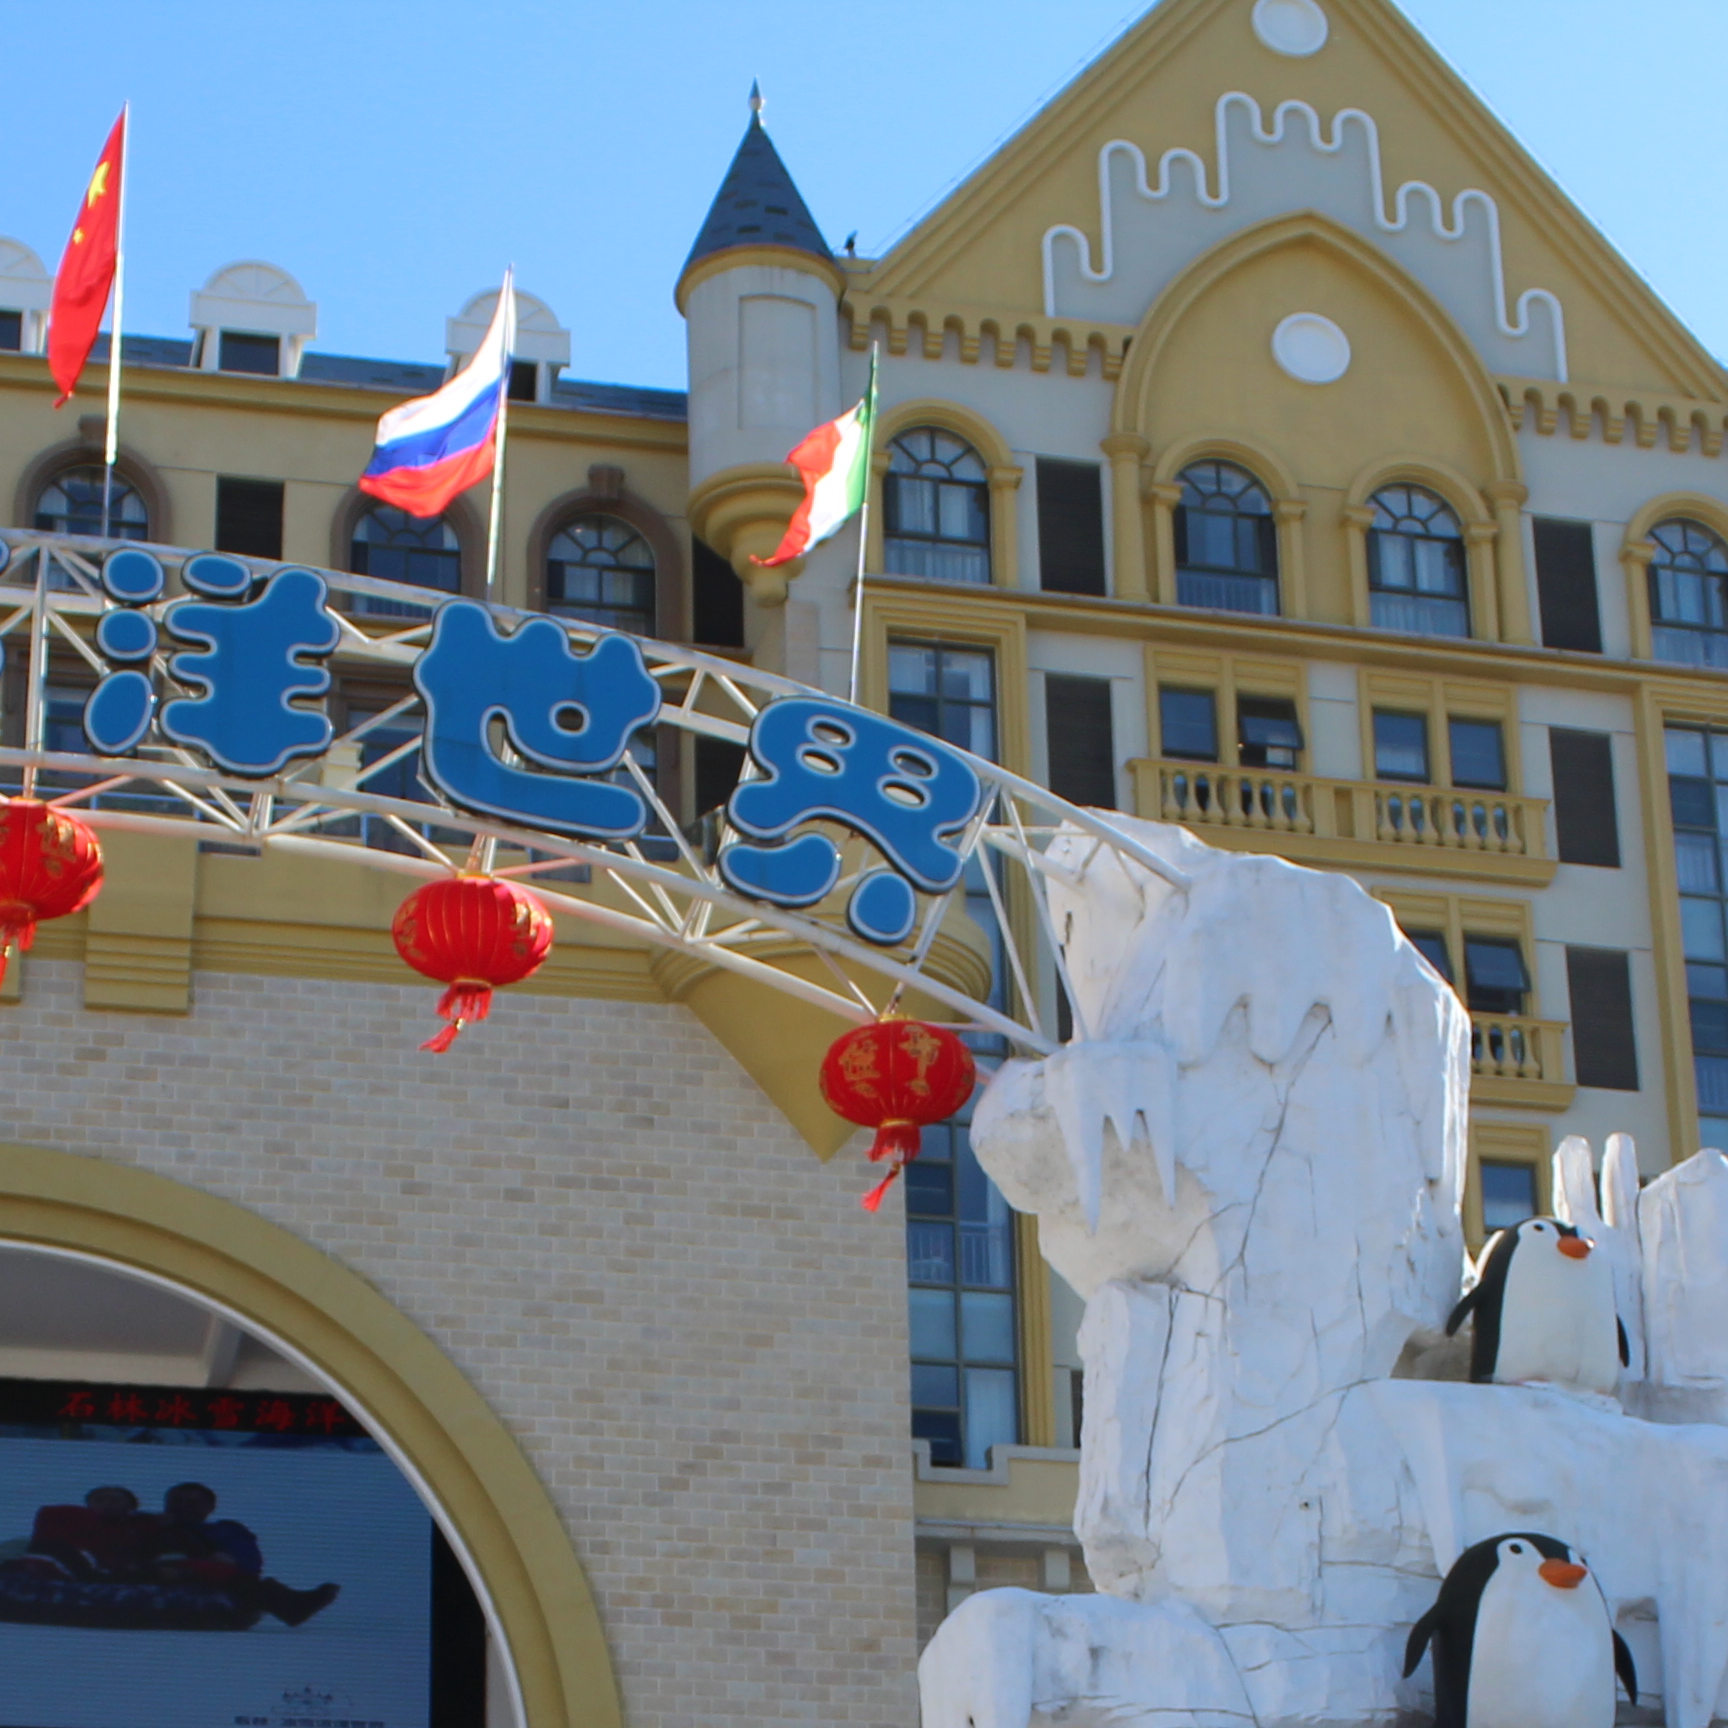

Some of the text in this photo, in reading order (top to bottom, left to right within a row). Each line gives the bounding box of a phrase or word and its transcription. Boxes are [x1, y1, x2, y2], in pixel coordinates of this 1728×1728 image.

[57, 1391, 371, 1433] 石林冰雪海洋
